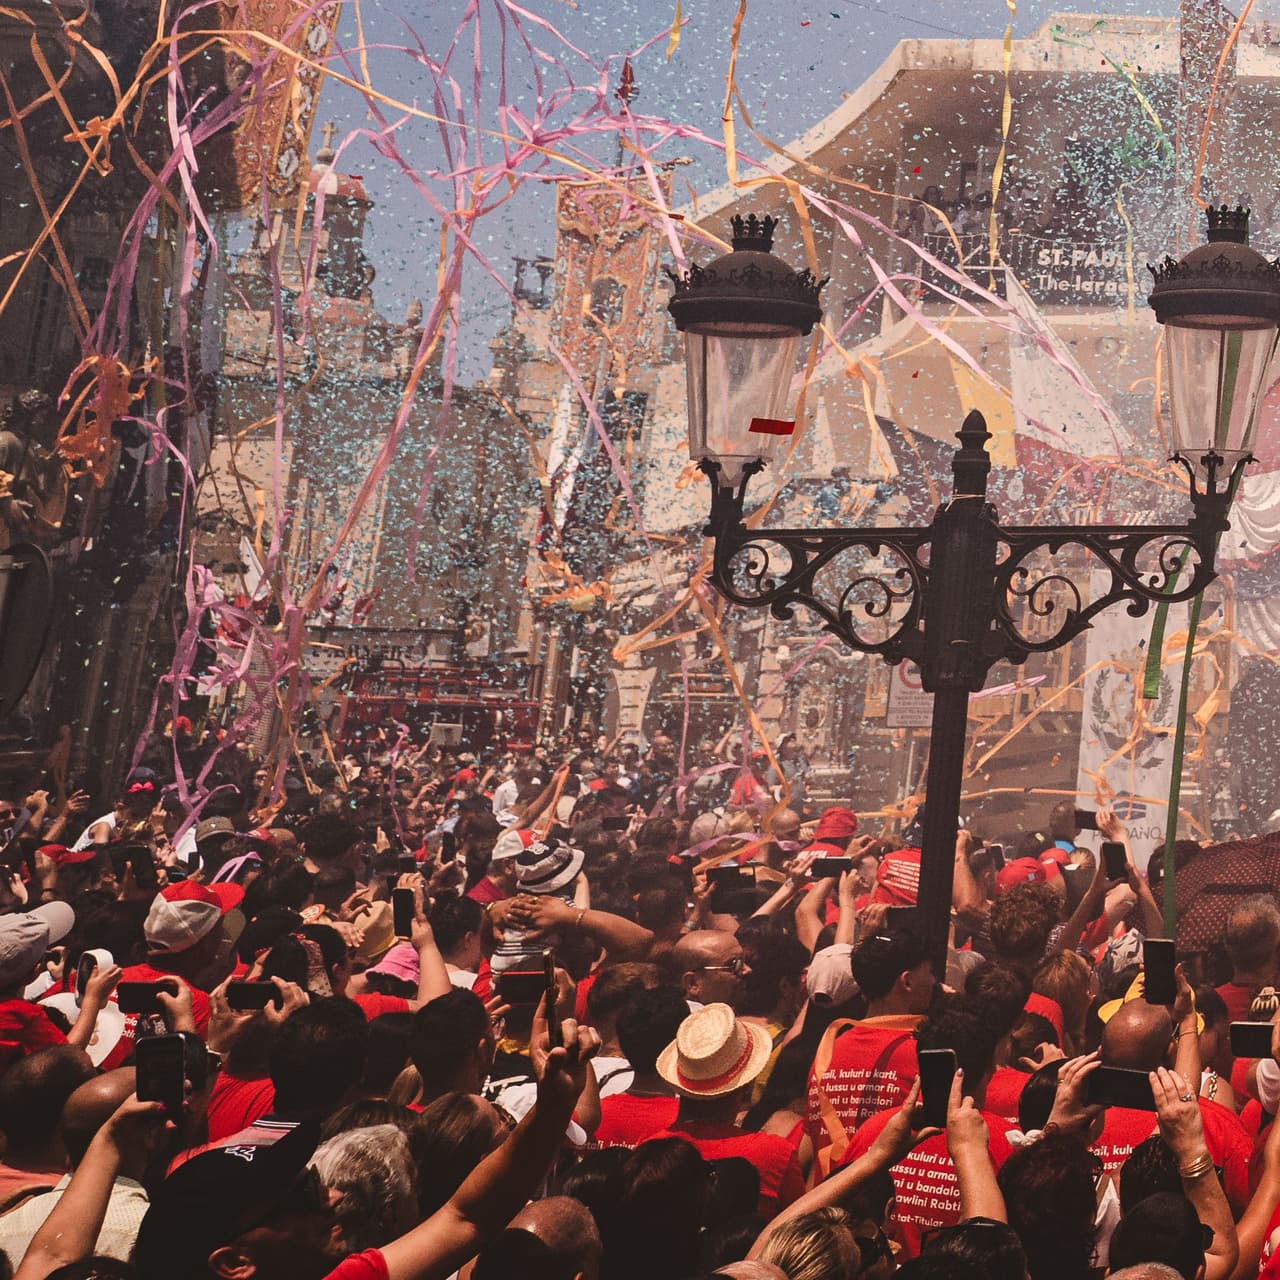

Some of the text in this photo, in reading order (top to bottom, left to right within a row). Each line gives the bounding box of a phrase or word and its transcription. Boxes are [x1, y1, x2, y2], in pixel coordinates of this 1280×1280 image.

[1036, 273, 1070, 291] The
[873, 1068, 898, 1081] karti,
[826, 1083, 849, 1092] lussu
[857, 1084, 885, 1092] armar
[850, 1095, 893, 1107] bandalori
[915, 1180, 961, 1197] bandalo
[929, 1197, 961, 1212] Rabti
[897, 1213, 944, 1228] tat-Titular
